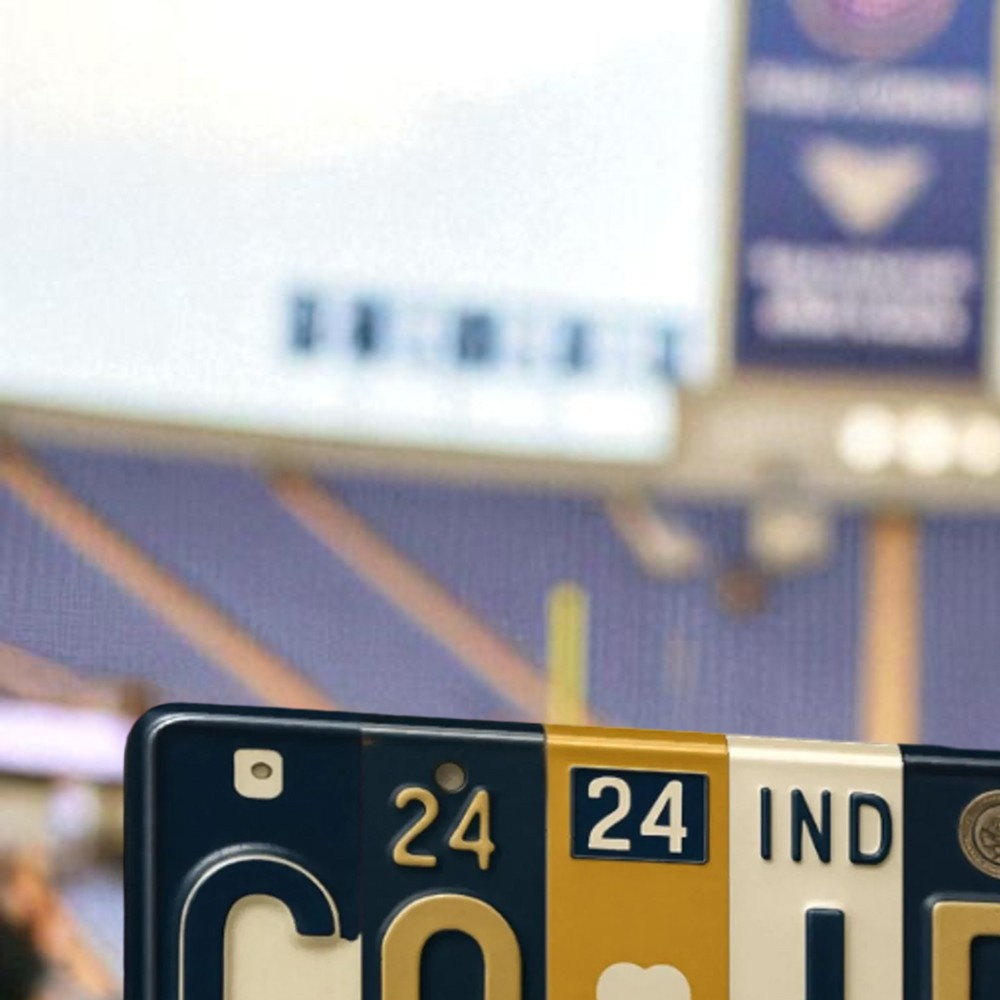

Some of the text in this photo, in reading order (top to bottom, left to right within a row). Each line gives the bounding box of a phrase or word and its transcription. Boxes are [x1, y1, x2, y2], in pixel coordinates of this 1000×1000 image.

[391, 786, 495, 870] 24
[586, 776, 687, 854] 24
[760, 787, 893, 865] IND
